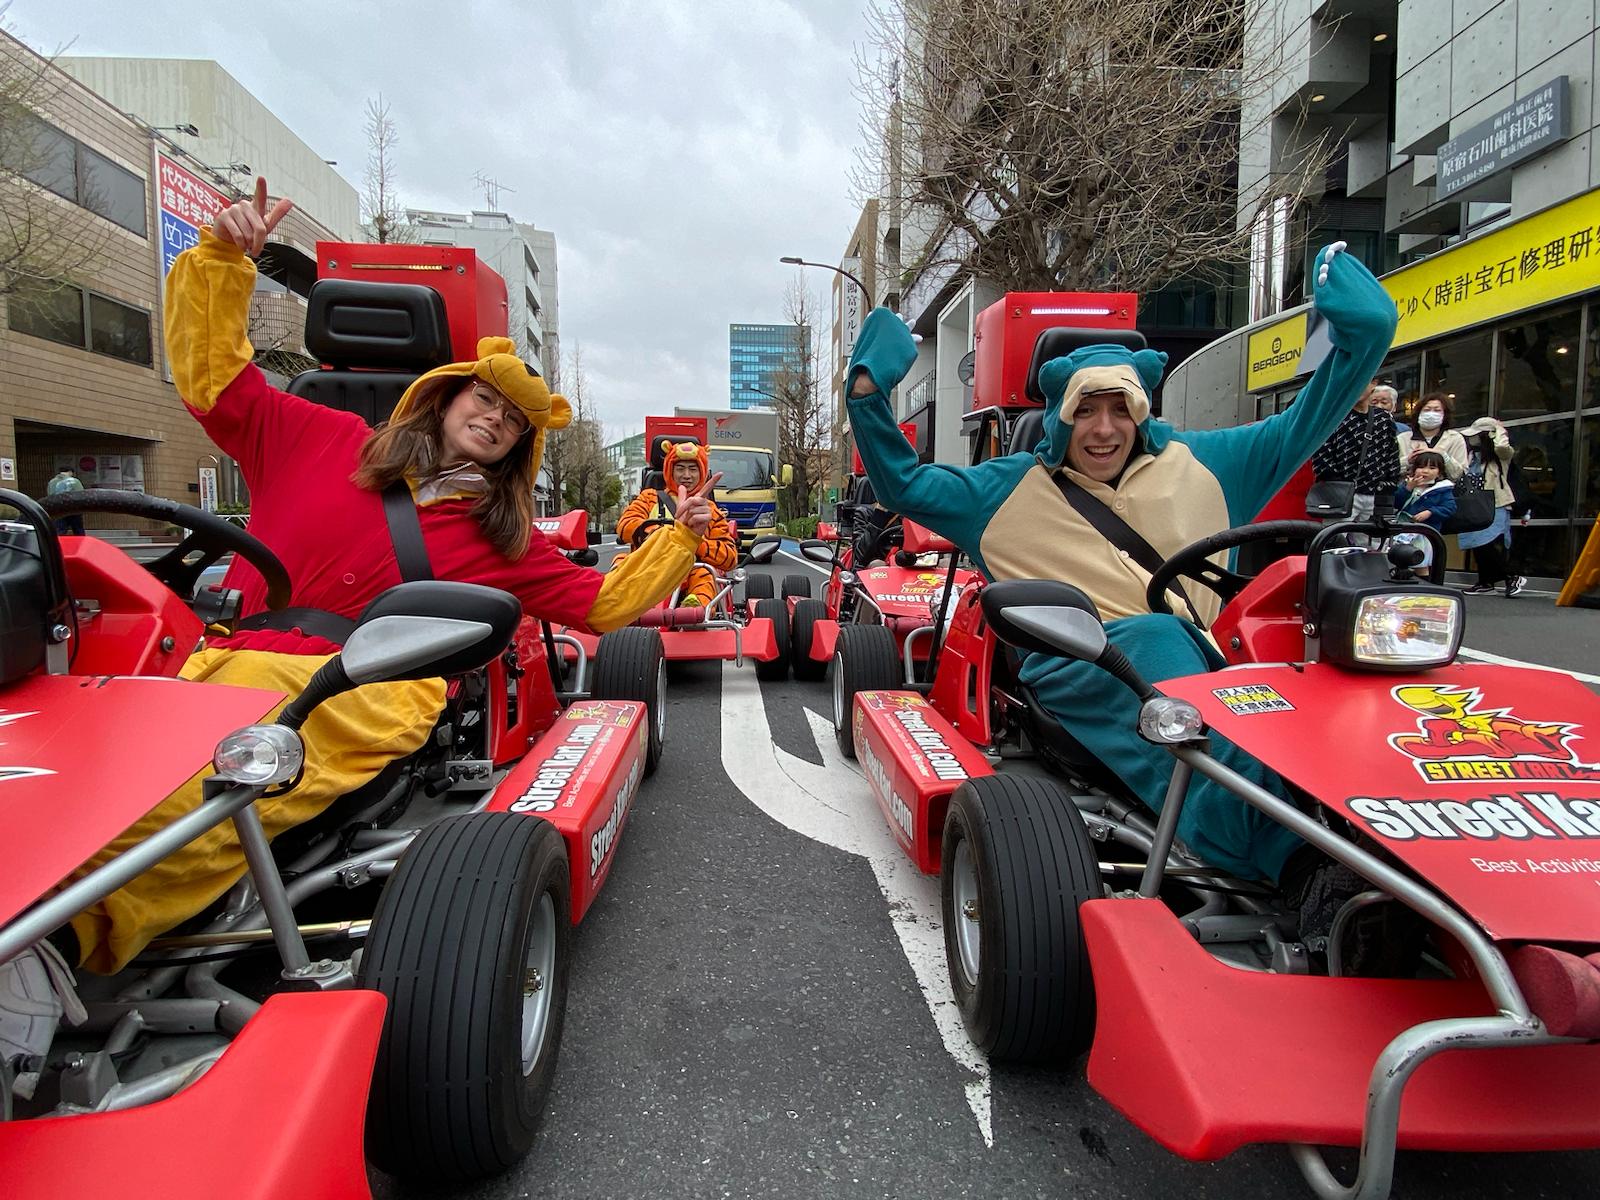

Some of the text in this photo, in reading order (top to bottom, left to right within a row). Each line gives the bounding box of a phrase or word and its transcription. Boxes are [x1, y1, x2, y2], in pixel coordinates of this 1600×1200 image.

[1442, 103, 1553, 178] 原宿石川歯科医院
[1253, 347, 1301, 372] BERGEON
[714, 430, 742, 439] SEINO
[876, 594, 921, 602] Street
[1349, 796, 1557, 839] Street
[1471, 857, 1527, 873] Best
